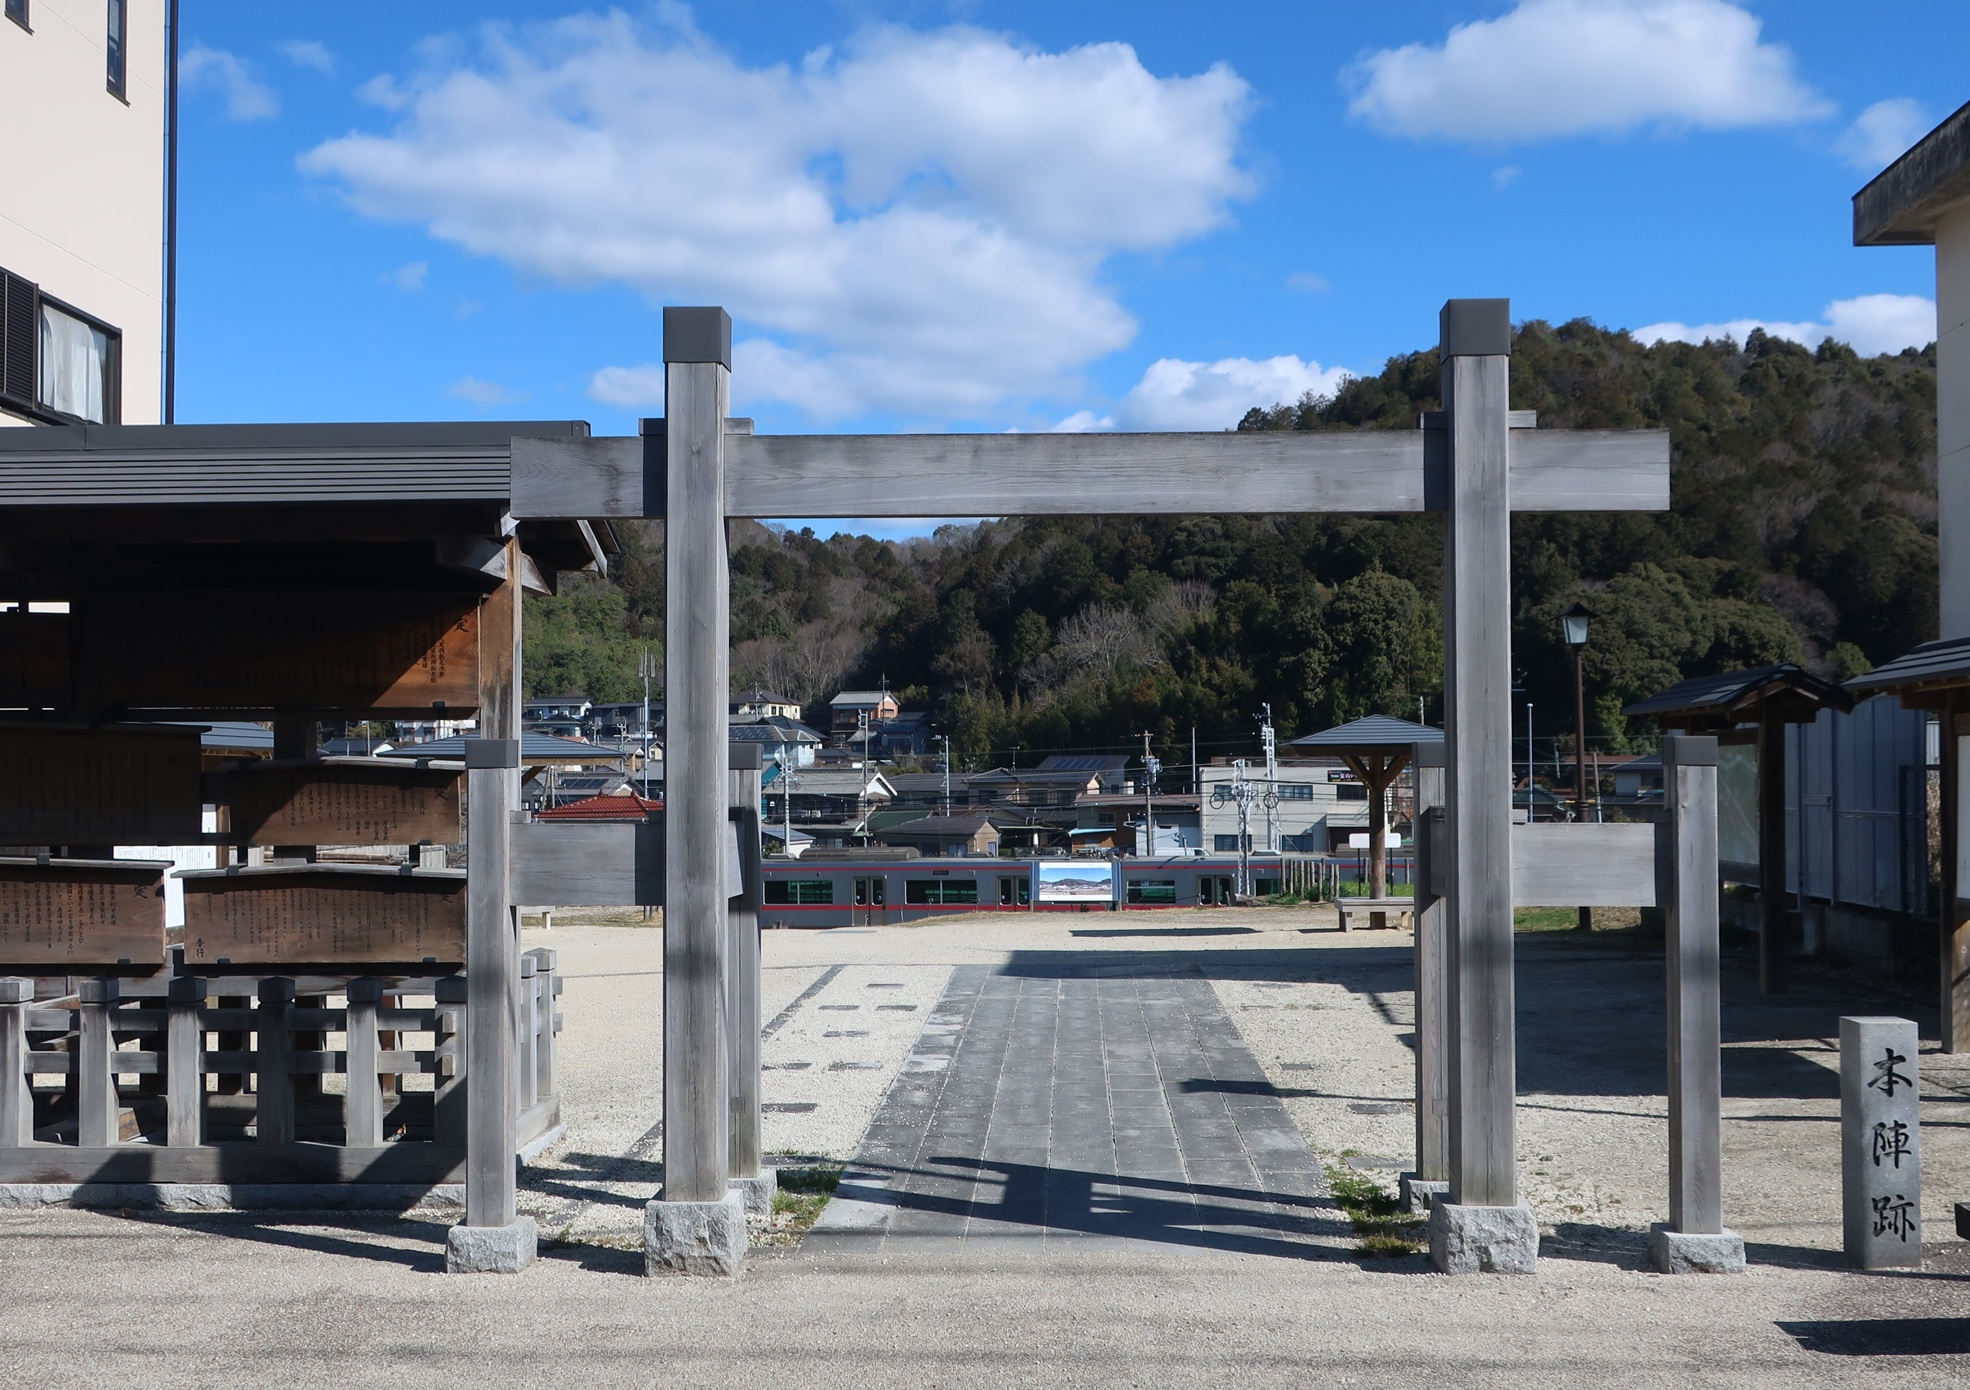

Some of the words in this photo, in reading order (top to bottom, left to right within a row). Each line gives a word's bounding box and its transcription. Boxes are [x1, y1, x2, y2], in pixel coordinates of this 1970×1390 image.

[134, 884, 149, 899] 定
[196, 937, 206, 958] 奉行
[1867, 1047, 1915, 1243] 本陣跡
